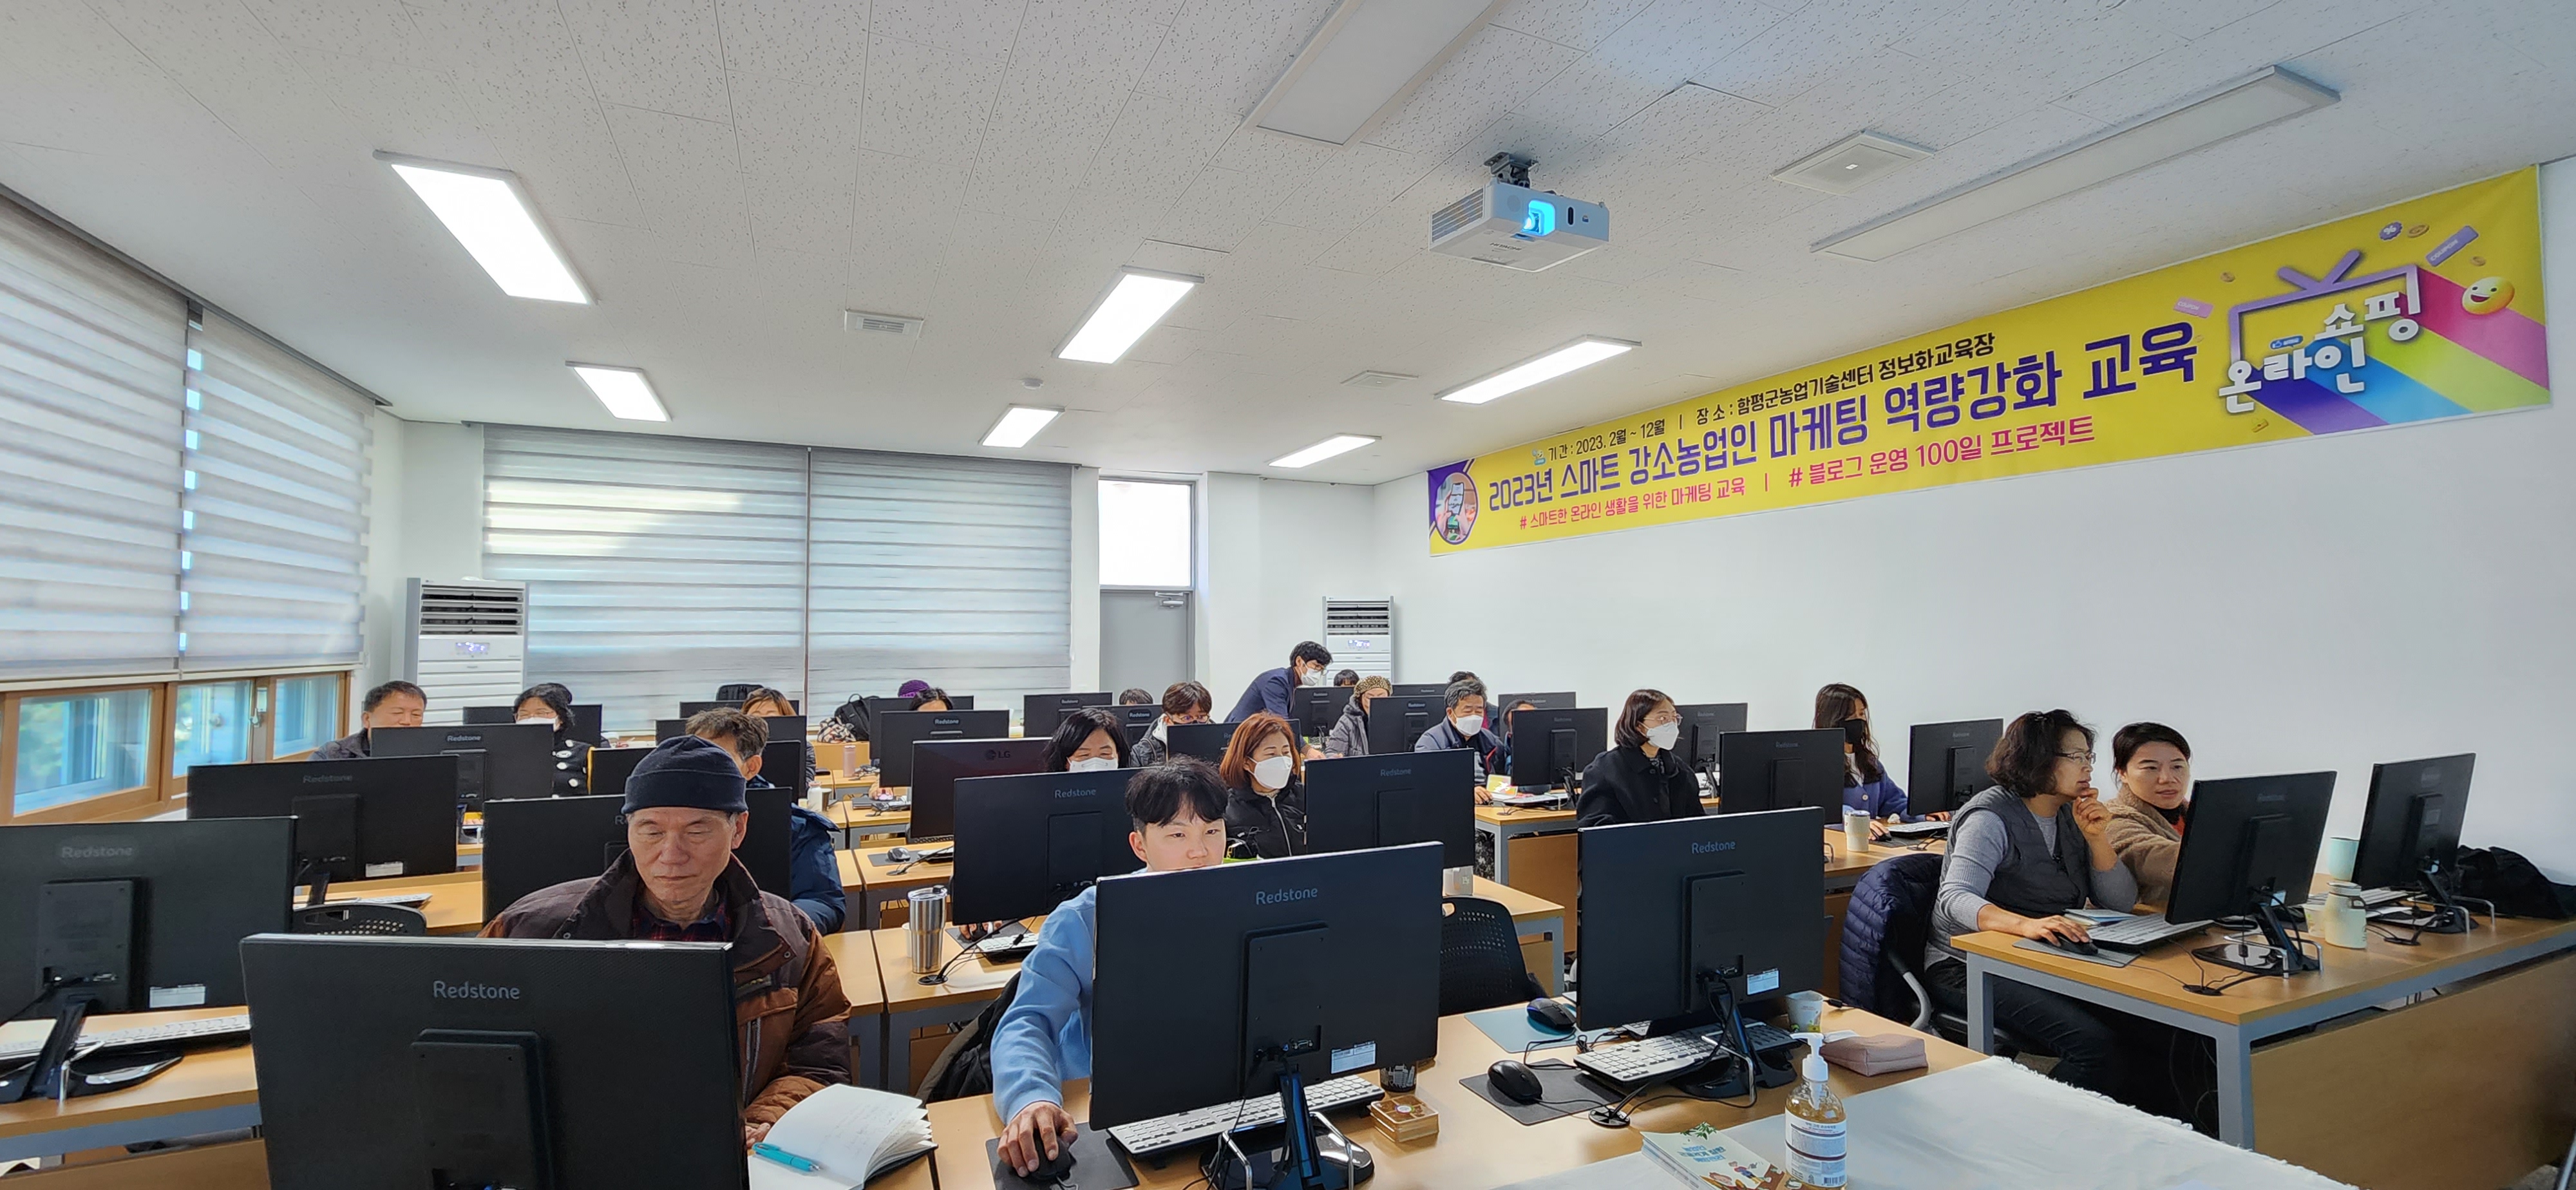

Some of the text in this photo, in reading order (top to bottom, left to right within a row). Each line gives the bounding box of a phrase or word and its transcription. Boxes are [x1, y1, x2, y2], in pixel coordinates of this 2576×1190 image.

[2177, 301, 2200, 310] COUPON
[2315, 274, 2421, 341] 쇼핑
[2219, 337, 2366, 414] 온라인
[1575, 437, 1607, 456] 2023.
[1609, 430, 1627, 447] 2월
[1640, 419, 1666, 439] 12월
[1737, 364, 1874, 415] 함평군농업기술센터
[1878, 332, 1995, 380] 정보화교육장
[1489, 321, 2198, 512] 2023년 스마트 강소농업인 마케팅 역량강화 교육
[1530, 504, 1567, 529] 스마트한
[1570, 500, 1602, 523] 온라인
[1605, 495, 1640, 518] 생활을
[1643, 491, 1668, 511] 위한
[1671, 482, 1712, 506] 마케팅
[1716, 477, 1746, 499] 교육
[1808, 456, 1864, 485] 블로그
[1869, 447, 1909, 476] 운영
[1915, 434, 1982, 468] 100일
[1990, 415, 2096, 456] 프로젝트
[998, 750, 1010, 759] LG
[1380, 768, 1412, 777] Redstone
[1054, 788, 1097, 799] Redstone
[61, 846, 133, 858] Redstone
[1691, 841, 1736, 855] Redstone
[1256, 888, 1319, 905] Redstone
[432, 980, 521, 1001] Redstone
